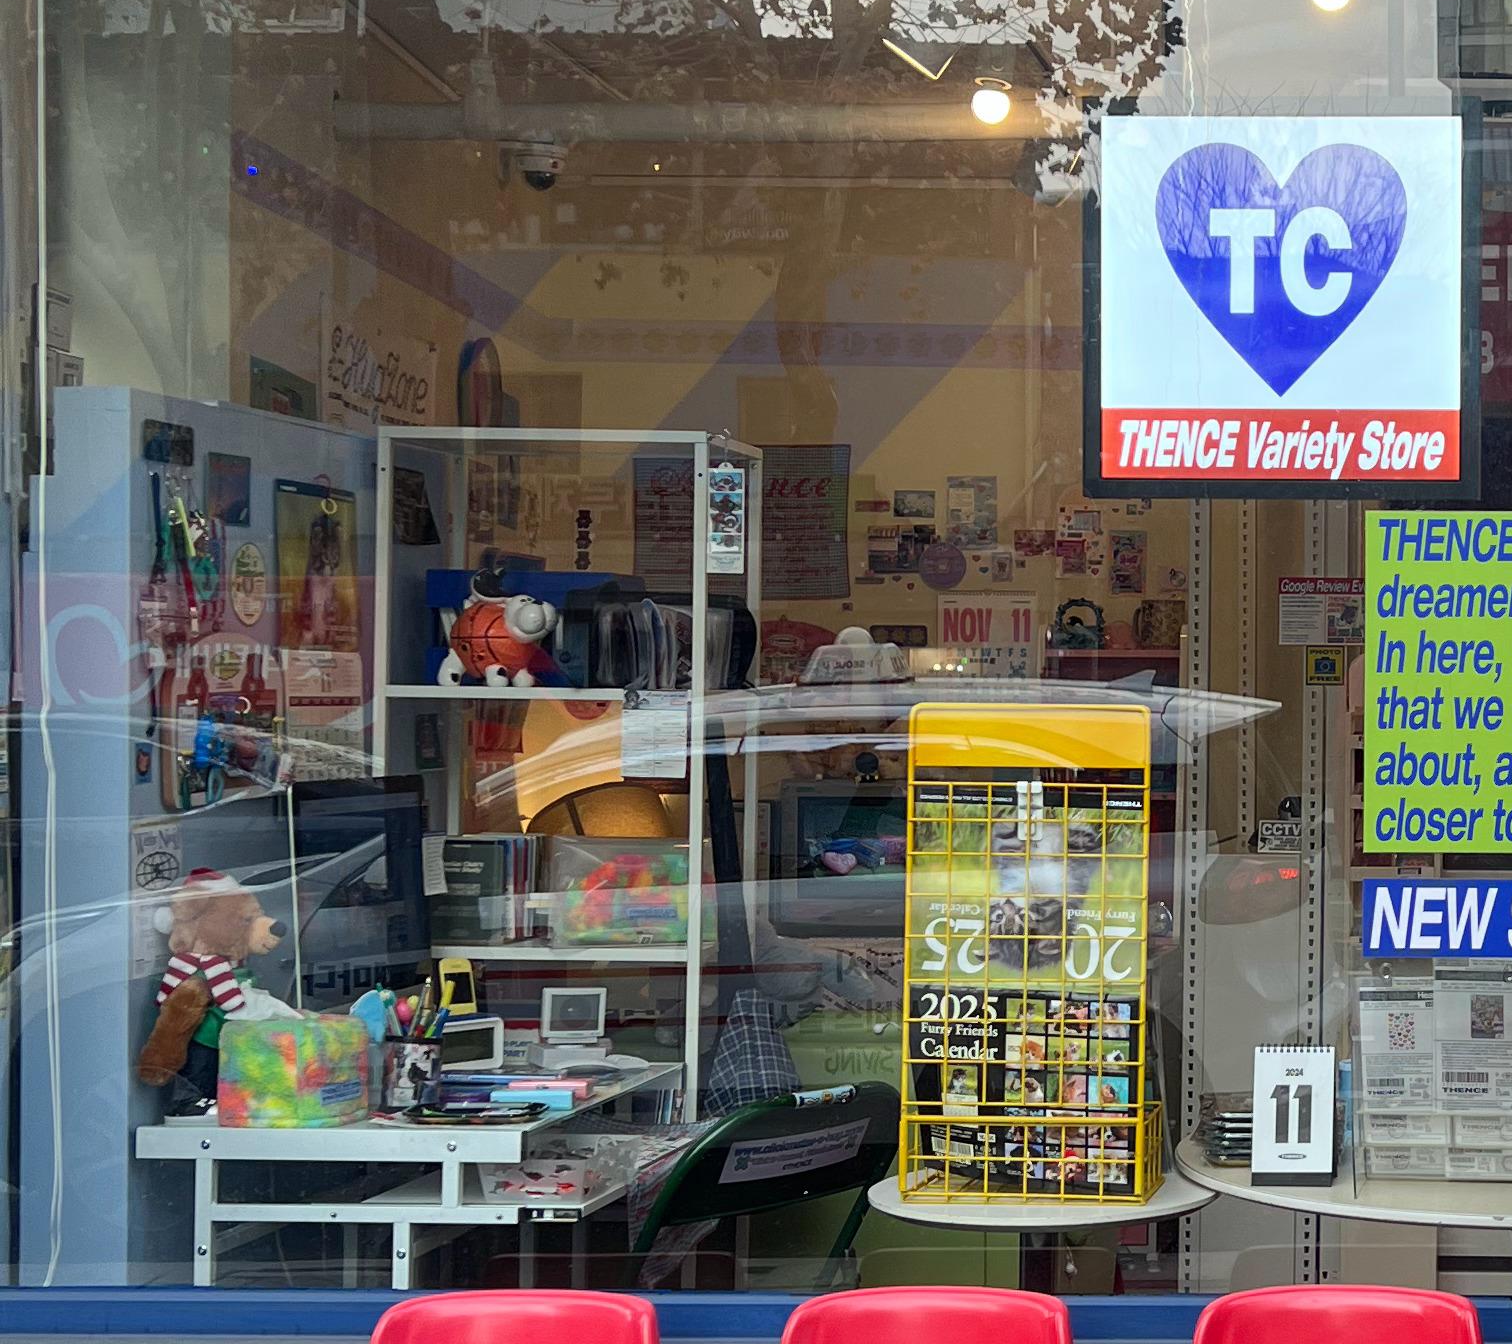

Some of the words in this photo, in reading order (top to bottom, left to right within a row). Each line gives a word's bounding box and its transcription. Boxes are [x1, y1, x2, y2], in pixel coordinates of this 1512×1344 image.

[1210, 207, 1353, 316] TC
[1119, 419, 1241, 469] THENCE
[1248, 419, 1355, 480] Variety
[1358, 420, 1446, 471] Store
[1281, 579, 1315, 595] Google
[1316, 579, 1350, 593] Review
[943, 608, 992, 643] NOV
[1012, 608, 1031, 643] 11
[1376, 631, 1405, 674] In
[1416, 631, 1502, 683] here,
[1377, 687, 1444, 731] that
[1453, 695, 1503, 731] we
[1376, 745, 1481, 795] about,
[1262, 823, 1301, 835] CCTV
[1376, 798, 1484, 843] closer
[1370, 887, 1499, 950] NEW
[920, 993, 999, 1024] 2025
[920, 1038, 999, 1061] Caendar
[1270, 1084, 1313, 1144] 11
